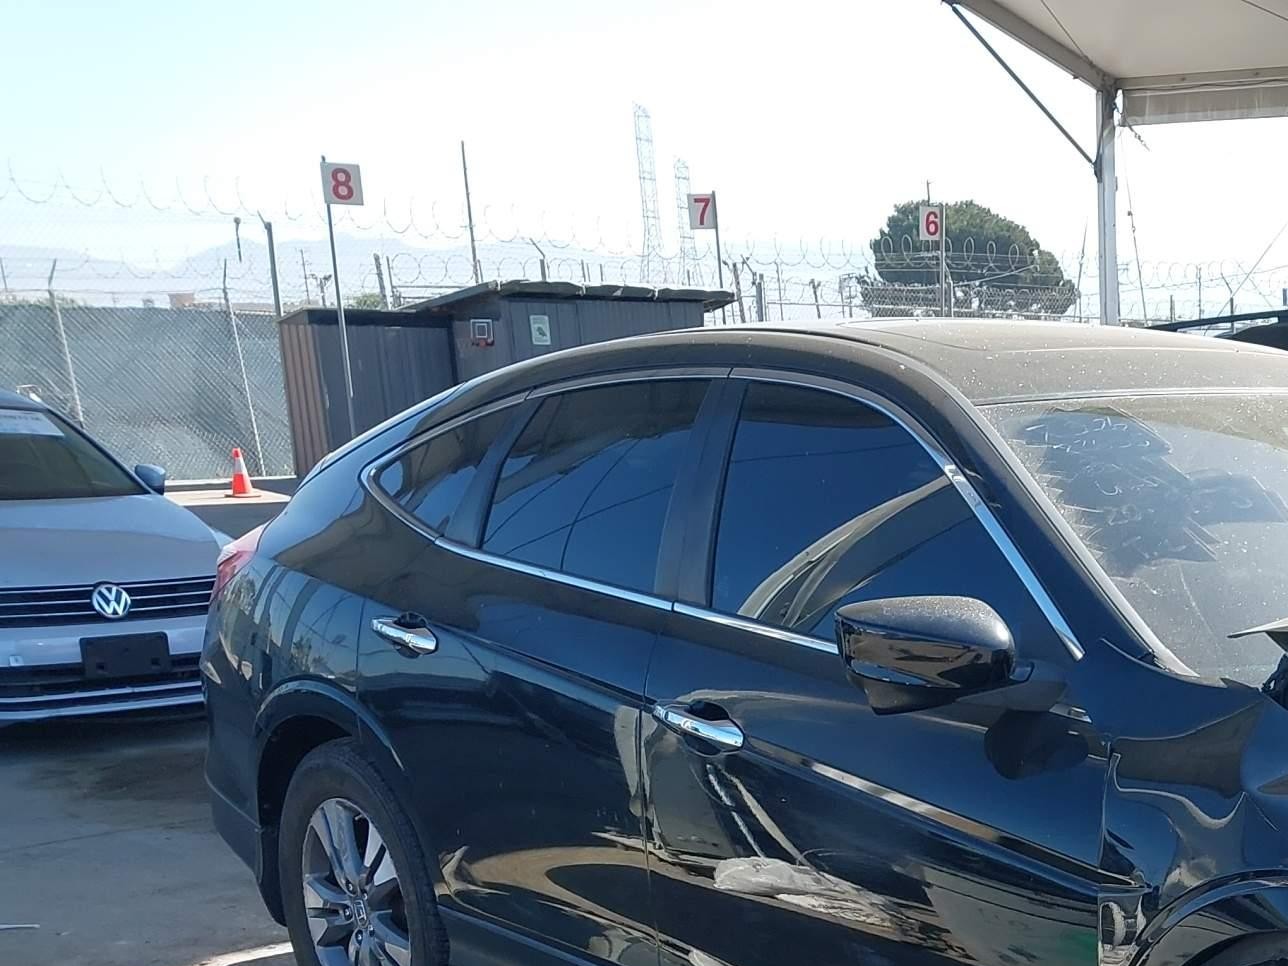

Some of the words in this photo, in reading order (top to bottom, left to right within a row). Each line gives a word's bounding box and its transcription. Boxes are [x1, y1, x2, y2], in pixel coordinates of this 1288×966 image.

[331, 167, 354, 201] 8
[693, 197, 710, 225] 7
[925, 210, 939, 236] 6
